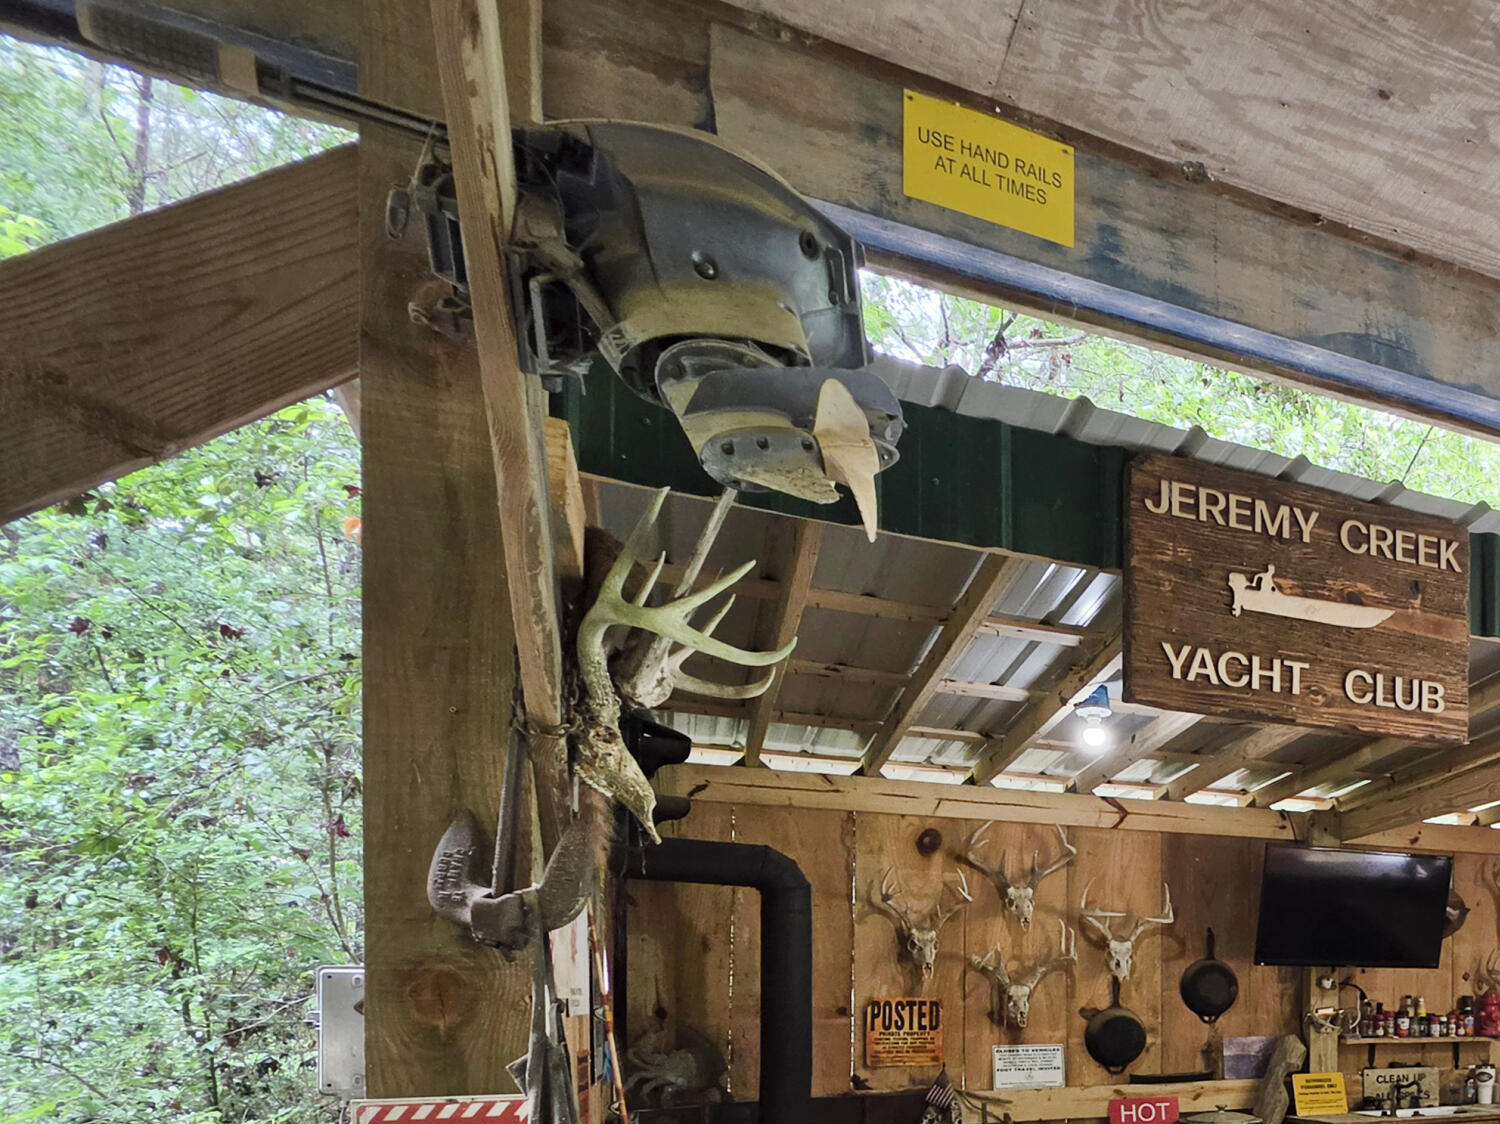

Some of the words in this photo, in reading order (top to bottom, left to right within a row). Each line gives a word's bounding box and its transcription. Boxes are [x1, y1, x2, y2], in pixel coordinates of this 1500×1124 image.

[918, 127, 954, 152] USE
[960, 139, 1009, 169] HAND
[1015, 158, 1062, 188] RAILS
[934, 156, 956, 174] AT
[960, 163, 991, 187] ALL
[996, 174, 1047, 205] TIMES
[1145, 479, 1320, 543] JEREMY
[1340, 520, 1462, 573] CREEK
[1161, 642, 1310, 695] YACHT
[1345, 670, 1446, 714] CLUB
[870, 1000, 940, 1031] POSTED
[1376, 1074, 1409, 1084] CLEAN
[1121, 1103, 1171, 1123] HOT
